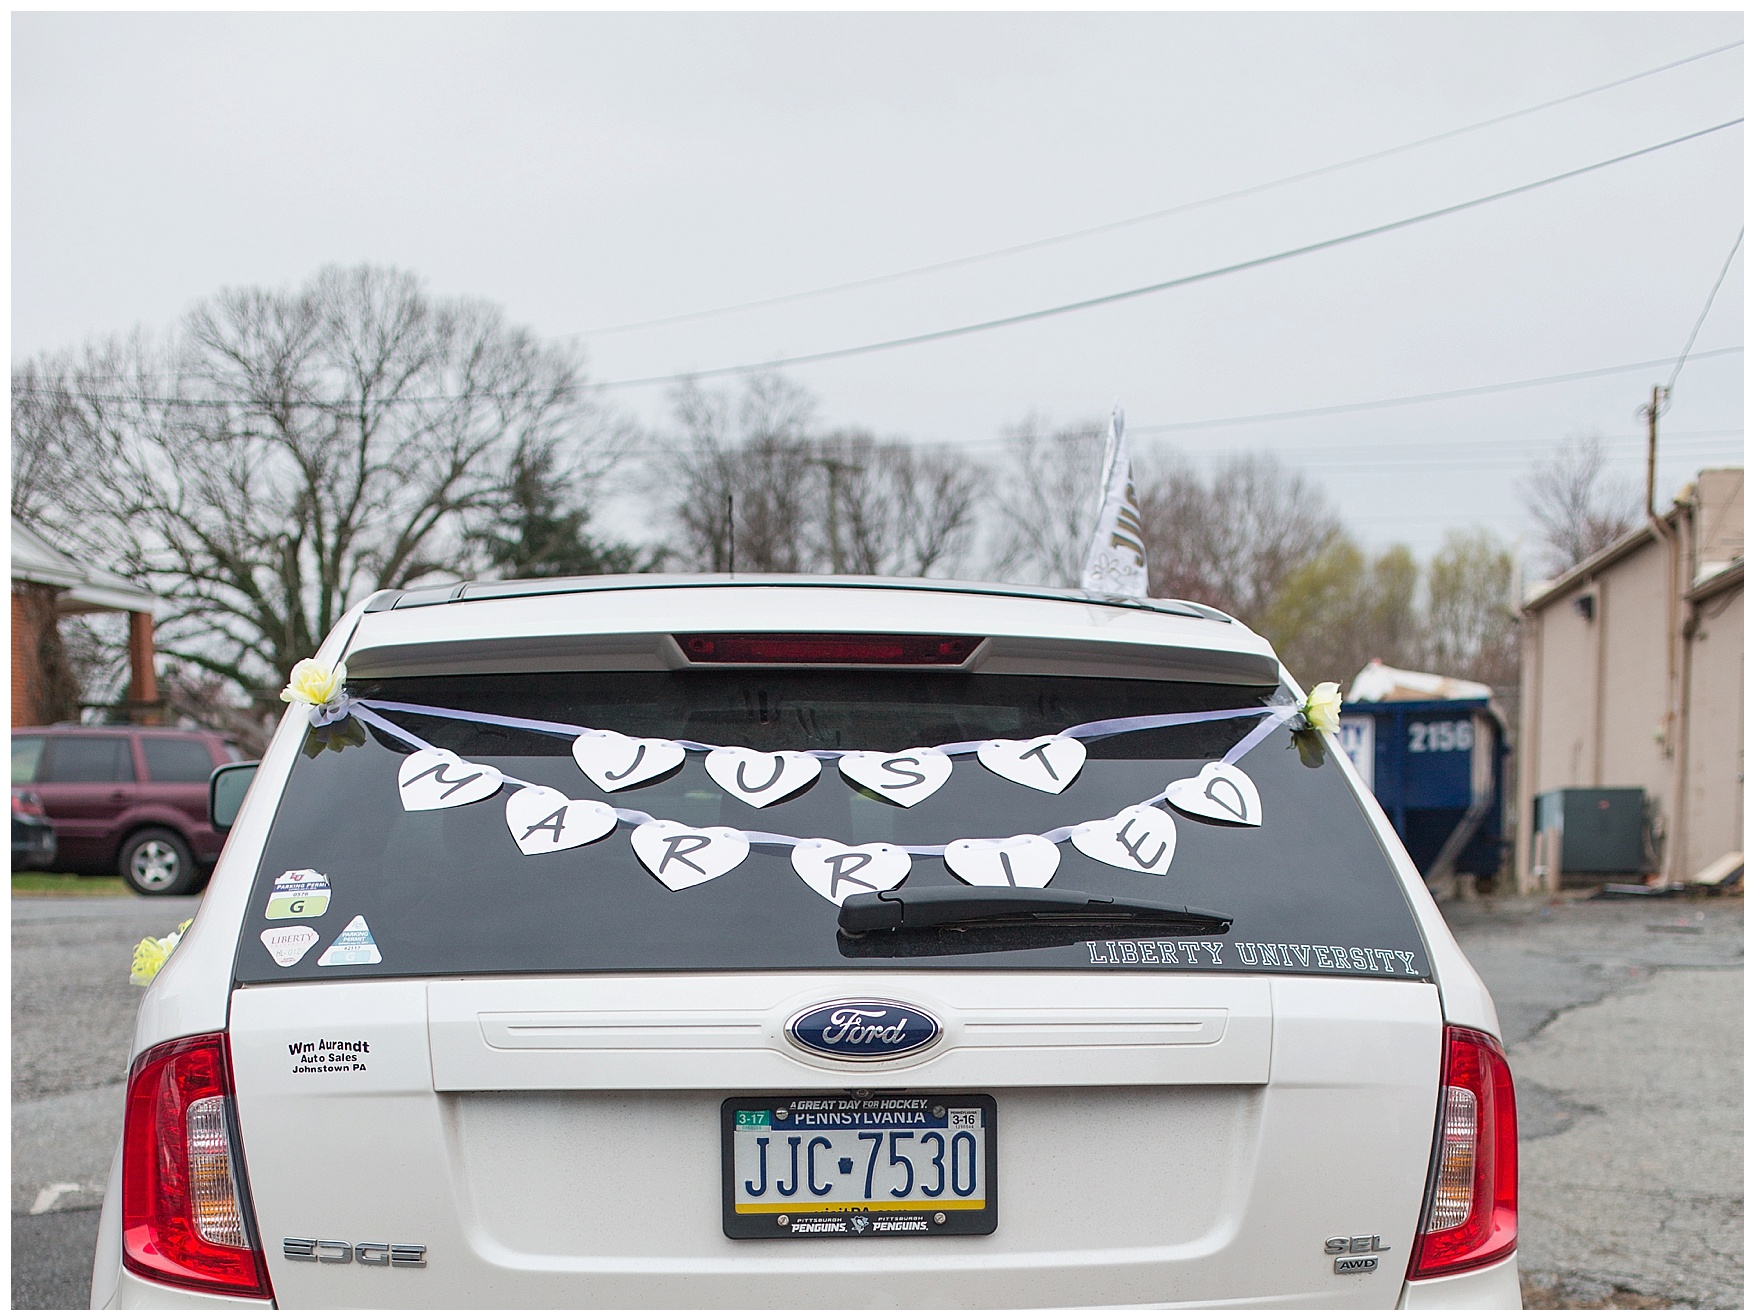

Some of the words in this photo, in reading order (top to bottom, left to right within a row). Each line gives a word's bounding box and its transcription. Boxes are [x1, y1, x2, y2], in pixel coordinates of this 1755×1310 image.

[1408, 721, 1474, 752] 2156
[605, 742, 1060, 793] JUST
[289, 900, 305, 914] G
[271, 933, 314, 945] LIBERTY
[1087, 941, 1223, 965] LIBERTY
[822, 1008, 908, 1045] Ford
[288, 1041, 315, 1056] Wm
[318, 1039, 370, 1054] Aurandt
[300, 1054, 325, 1063] Auto
[328, 1053, 358, 1062] Sales
[292, 1065, 350, 1073] Johnstown
[353, 1063, 367, 1072] PA
[790, 1101, 797, 1110] A
[797, 1100, 836, 1110] GREAT
[838, 1100, 861, 1110] DAY
[863, 1100, 880, 1109] FOR
[739, 1114, 765, 1124] 3-17
[795, 1112, 926, 1125] PENNSYLVANIA
[952, 1114, 975, 1125] 3-16
[1324, 1234, 1391, 1255] SEL
[283, 1236, 427, 1268] EDGE
[1340, 1260, 1375, 1269] AWD
